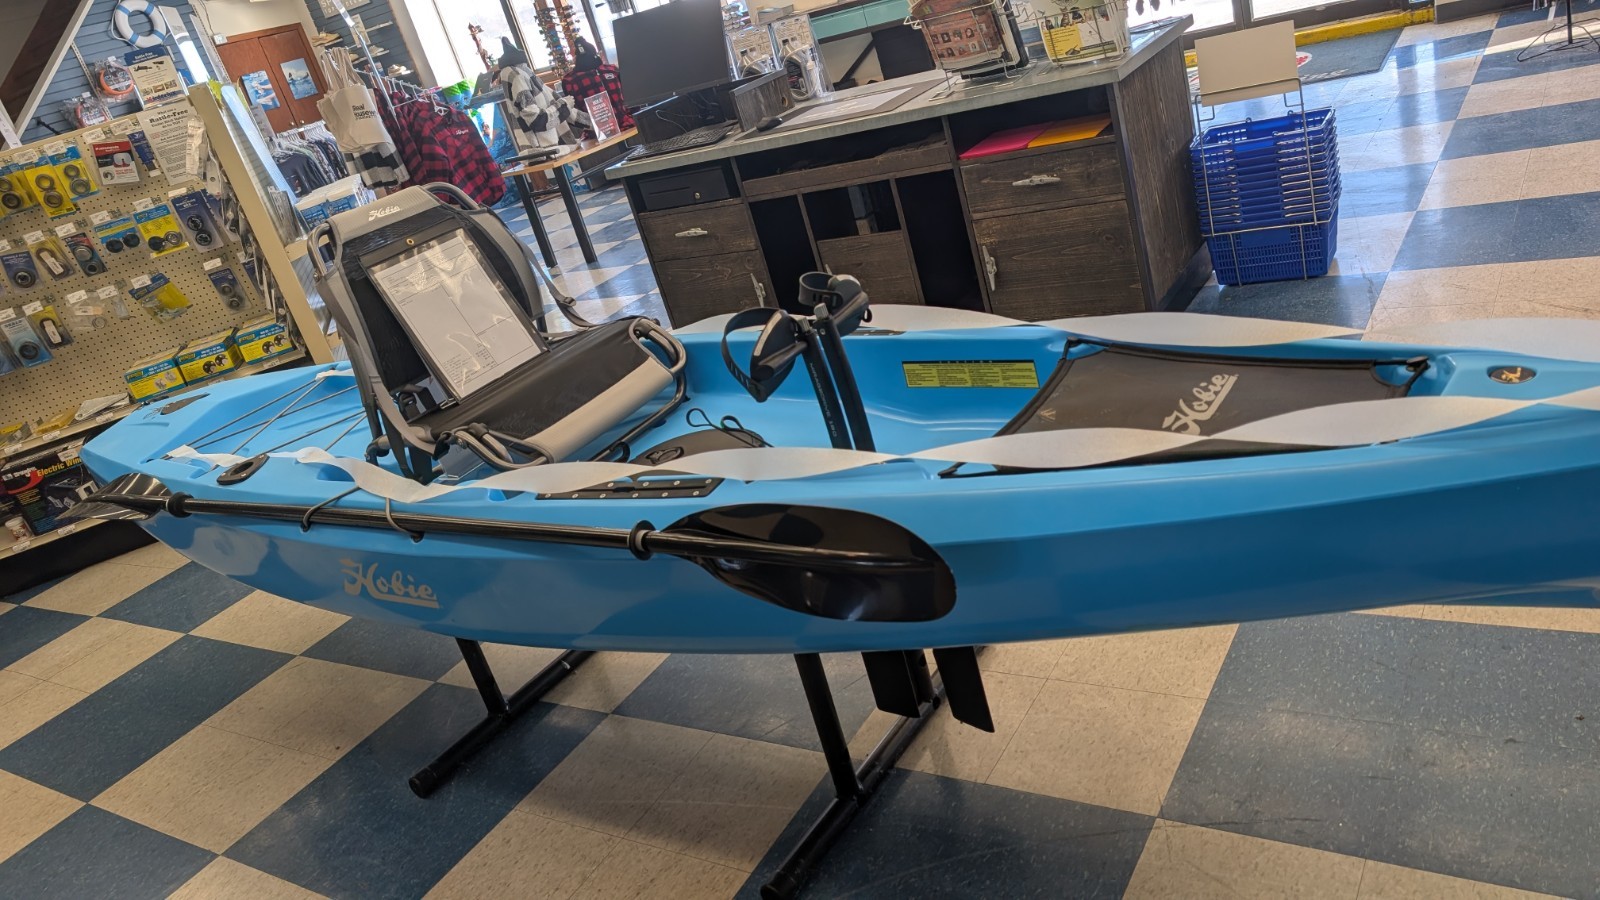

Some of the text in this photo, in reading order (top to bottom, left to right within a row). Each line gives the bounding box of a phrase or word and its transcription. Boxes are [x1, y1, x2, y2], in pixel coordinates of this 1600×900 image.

[368, 206, 400, 221] Hobie
[1162, 373, 1239, 435] Hobie
[37, 462, 65, 477] Electric
[65, 457, 82, 467] Win
[340, 559, 440, 609] Hobie
